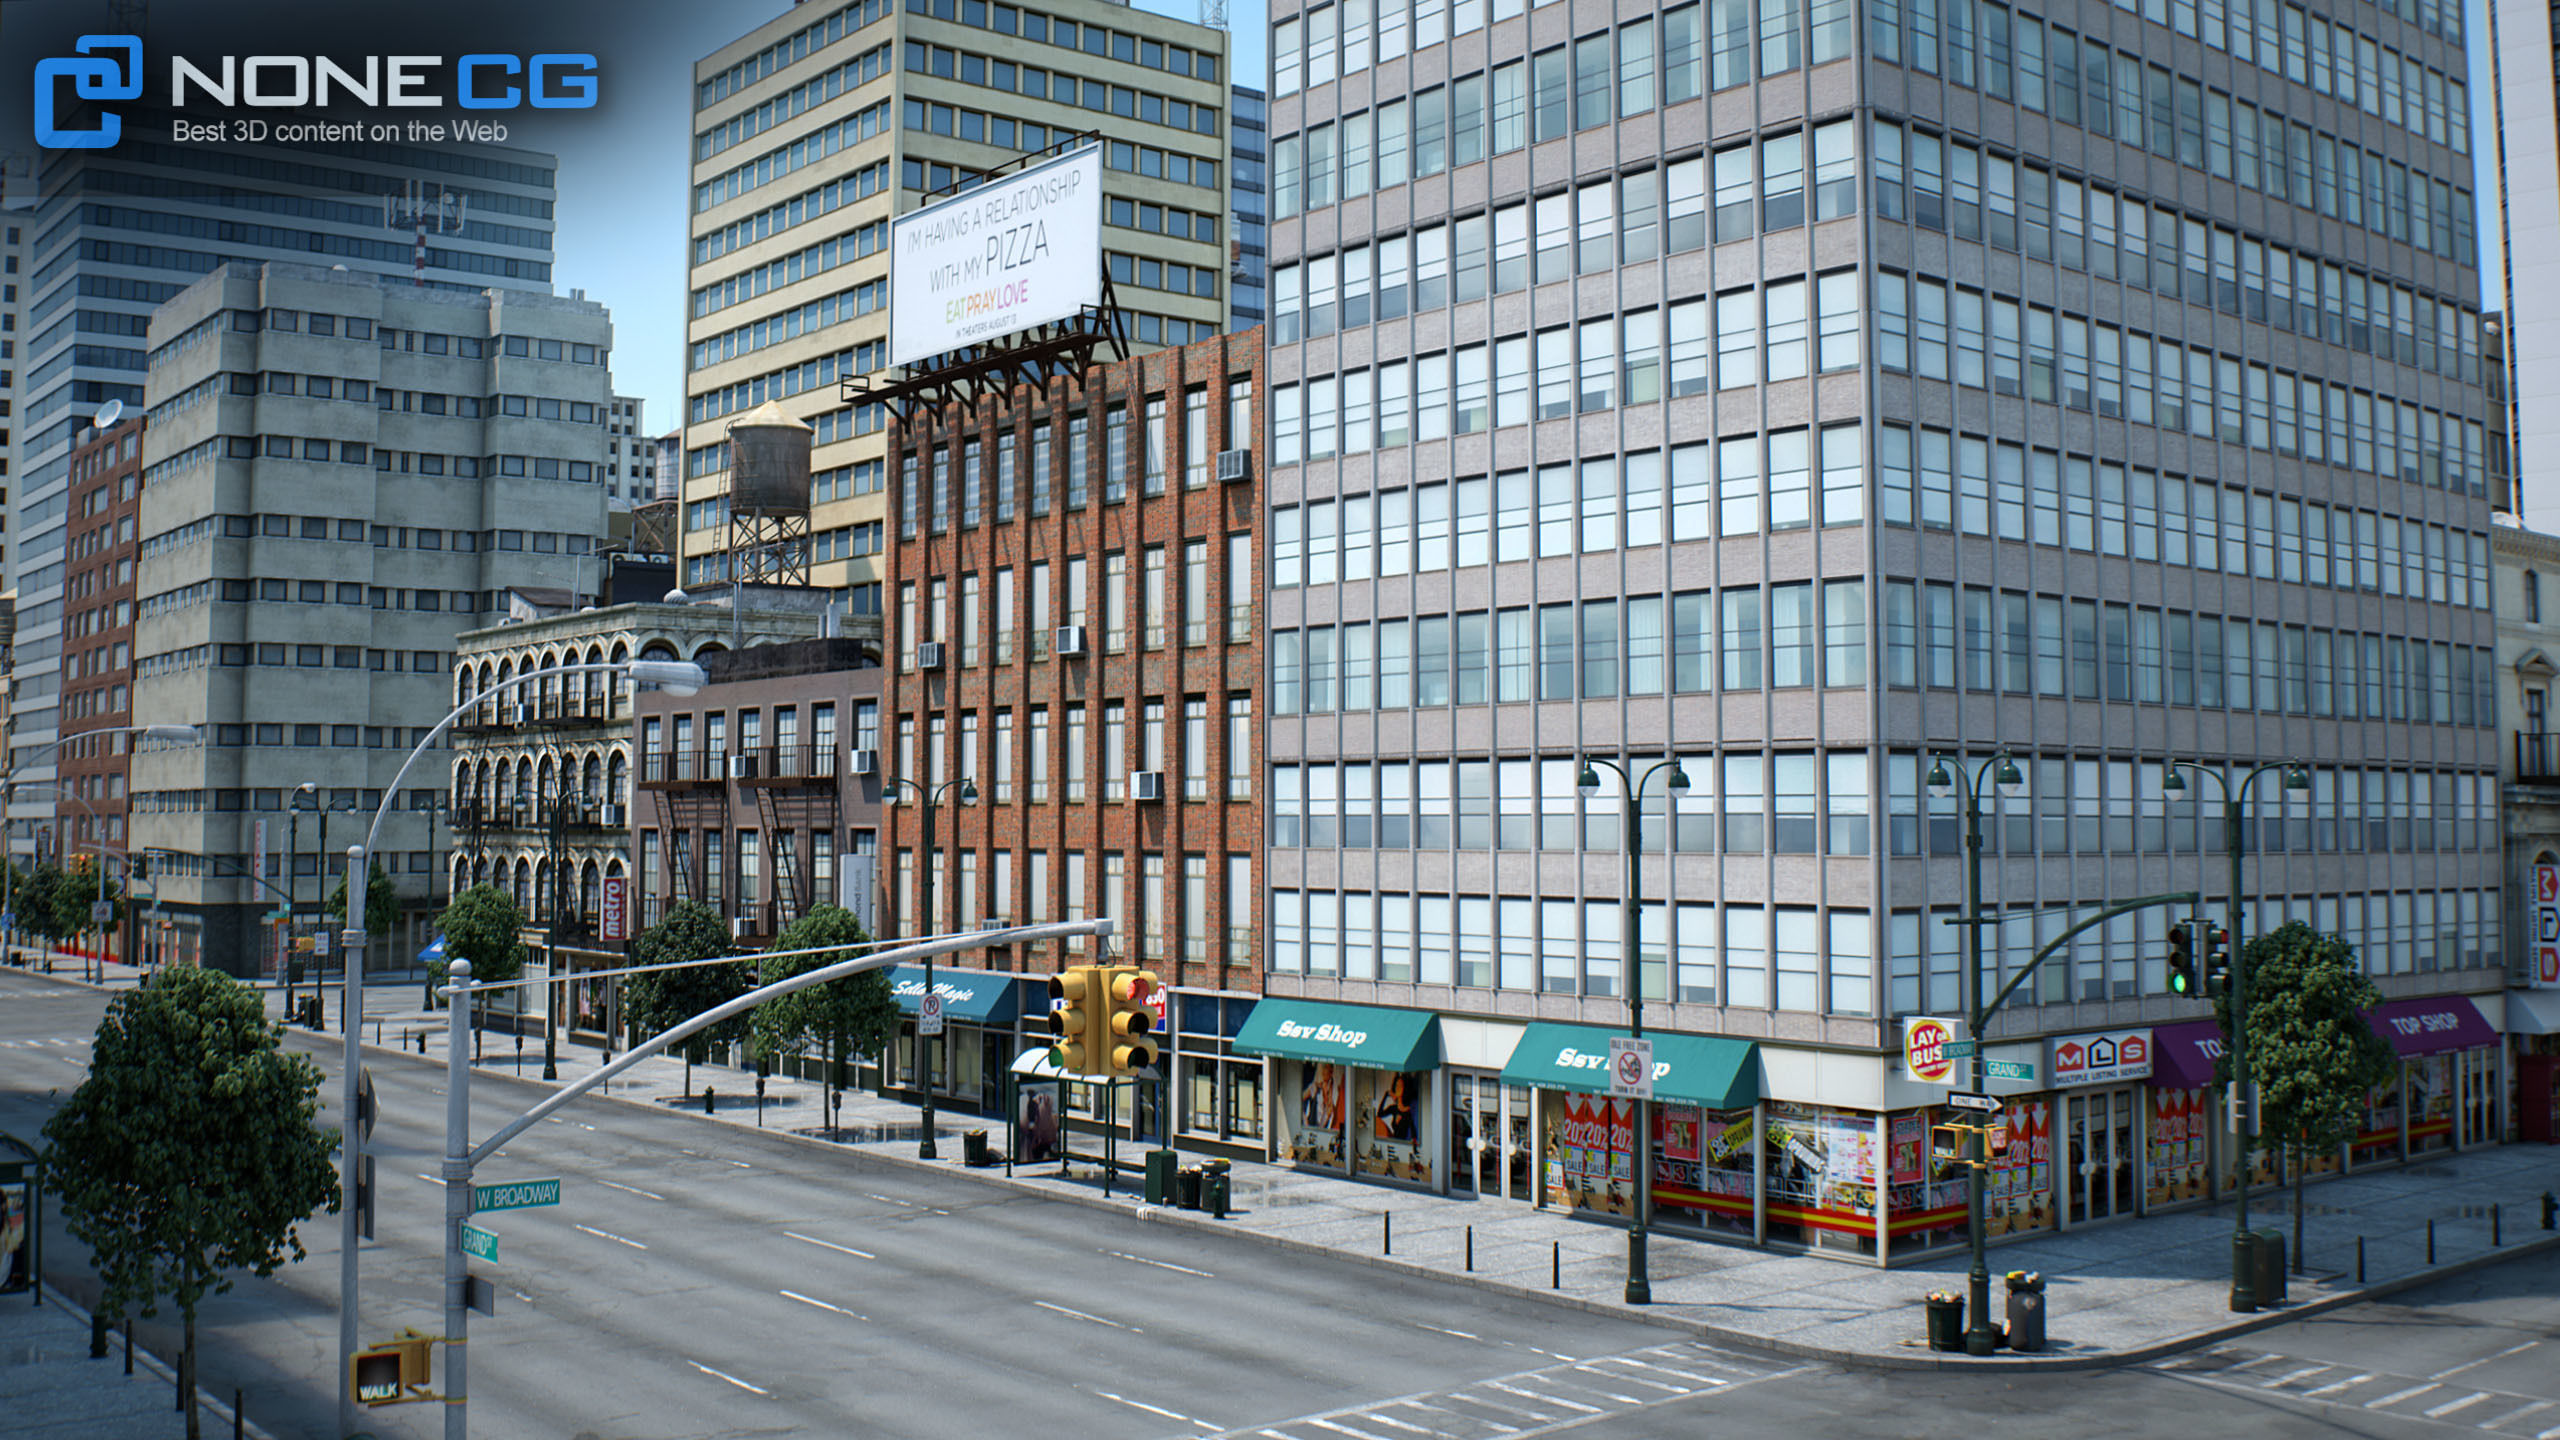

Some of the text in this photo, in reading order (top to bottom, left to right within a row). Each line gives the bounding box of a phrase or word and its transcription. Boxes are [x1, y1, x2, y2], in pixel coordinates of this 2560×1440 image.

[925, 211, 968, 248] HAVING
[972, 208, 982, 232] A
[985, 170, 1081, 227] RELATIONSHIP
[930, 219, 1049, 293] WITH MY PIZZA
[606, 881, 620, 937] metro
[1314, 1022, 1368, 1048] Shop
[2389, 1012, 2459, 1036] TOP SHOP
[1910, 1028, 1937, 1049] LAY
[2194, 1038, 2230, 1060] TO
[1987, 1062, 2020, 1078] GRAND
[2056, 1066, 2148, 1084] MULTIPLE LISTING SERVICE
[477, 1183, 558, 1208] W BROADWAY
[463, 1228, 487, 1256] GRAND
[360, 1381, 398, 1401] WALK
